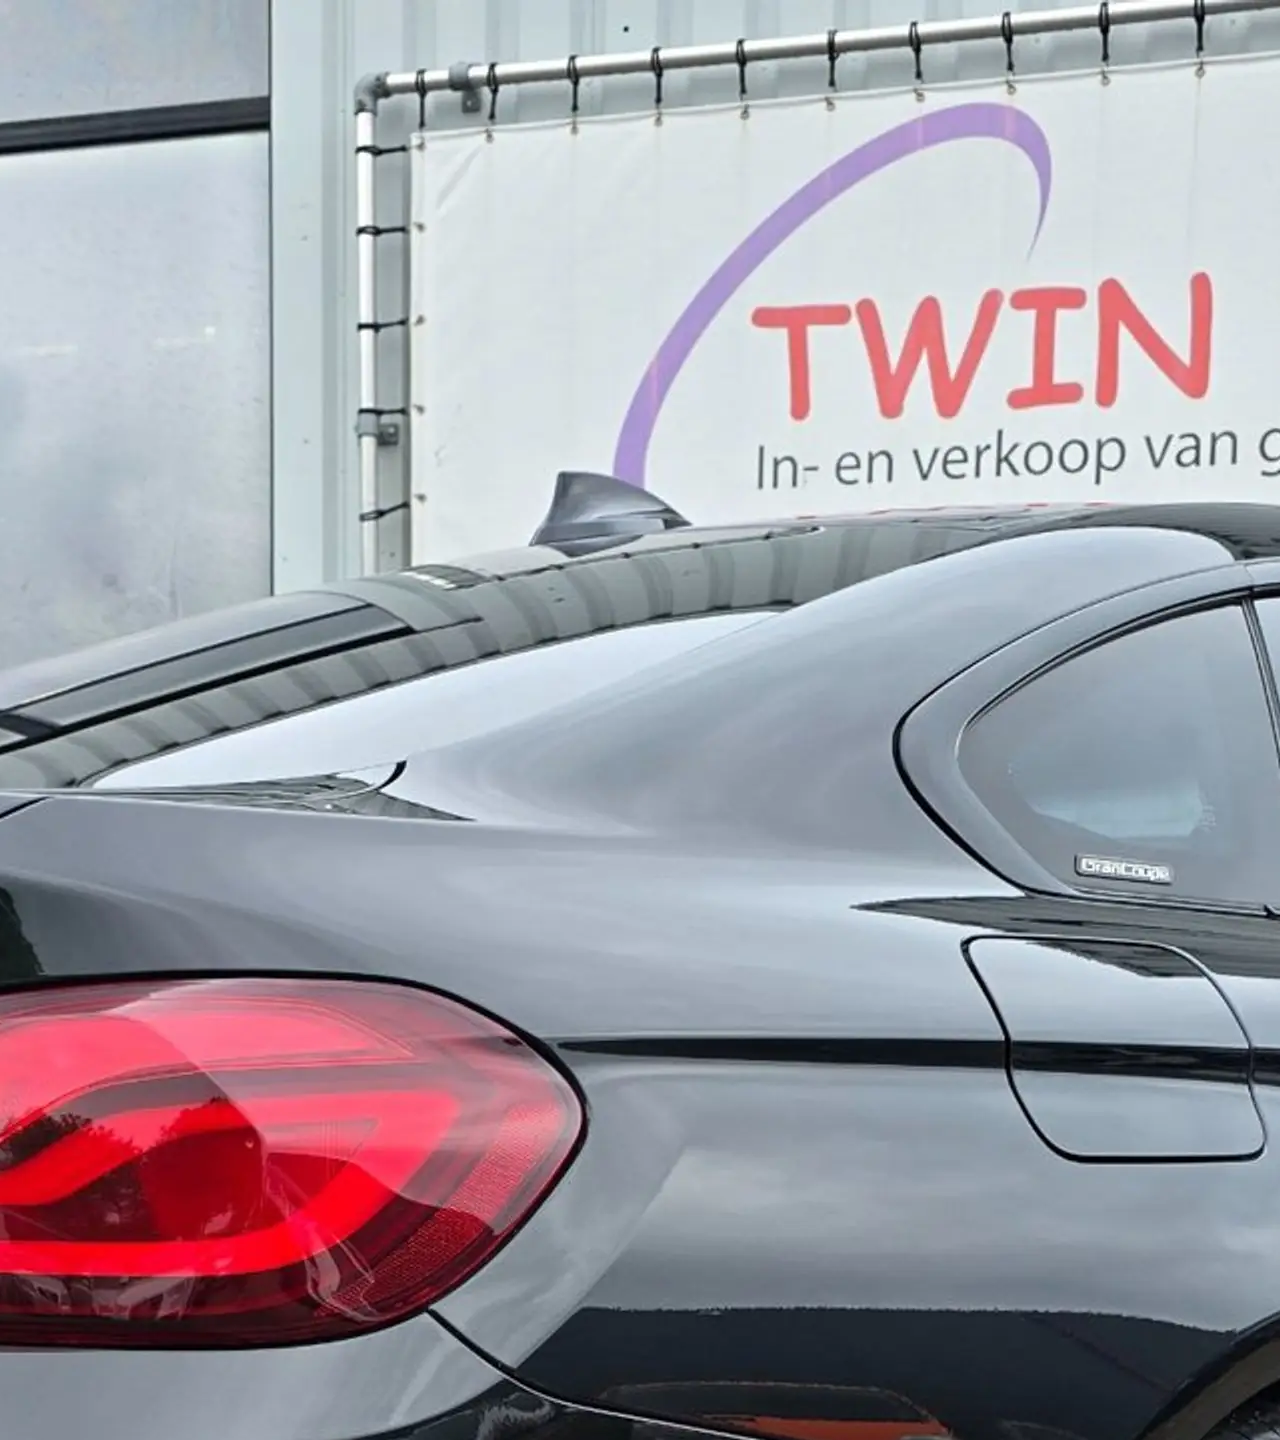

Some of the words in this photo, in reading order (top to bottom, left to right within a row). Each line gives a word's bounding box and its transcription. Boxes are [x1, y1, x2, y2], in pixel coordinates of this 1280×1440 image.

[751, 271, 1213, 421] TWIN
[757, 445, 818, 490] In-
[835, 450, 894, 485] en
[912, 429, 1127, 486] verkoop
[1145, 431, 1239, 468] van
